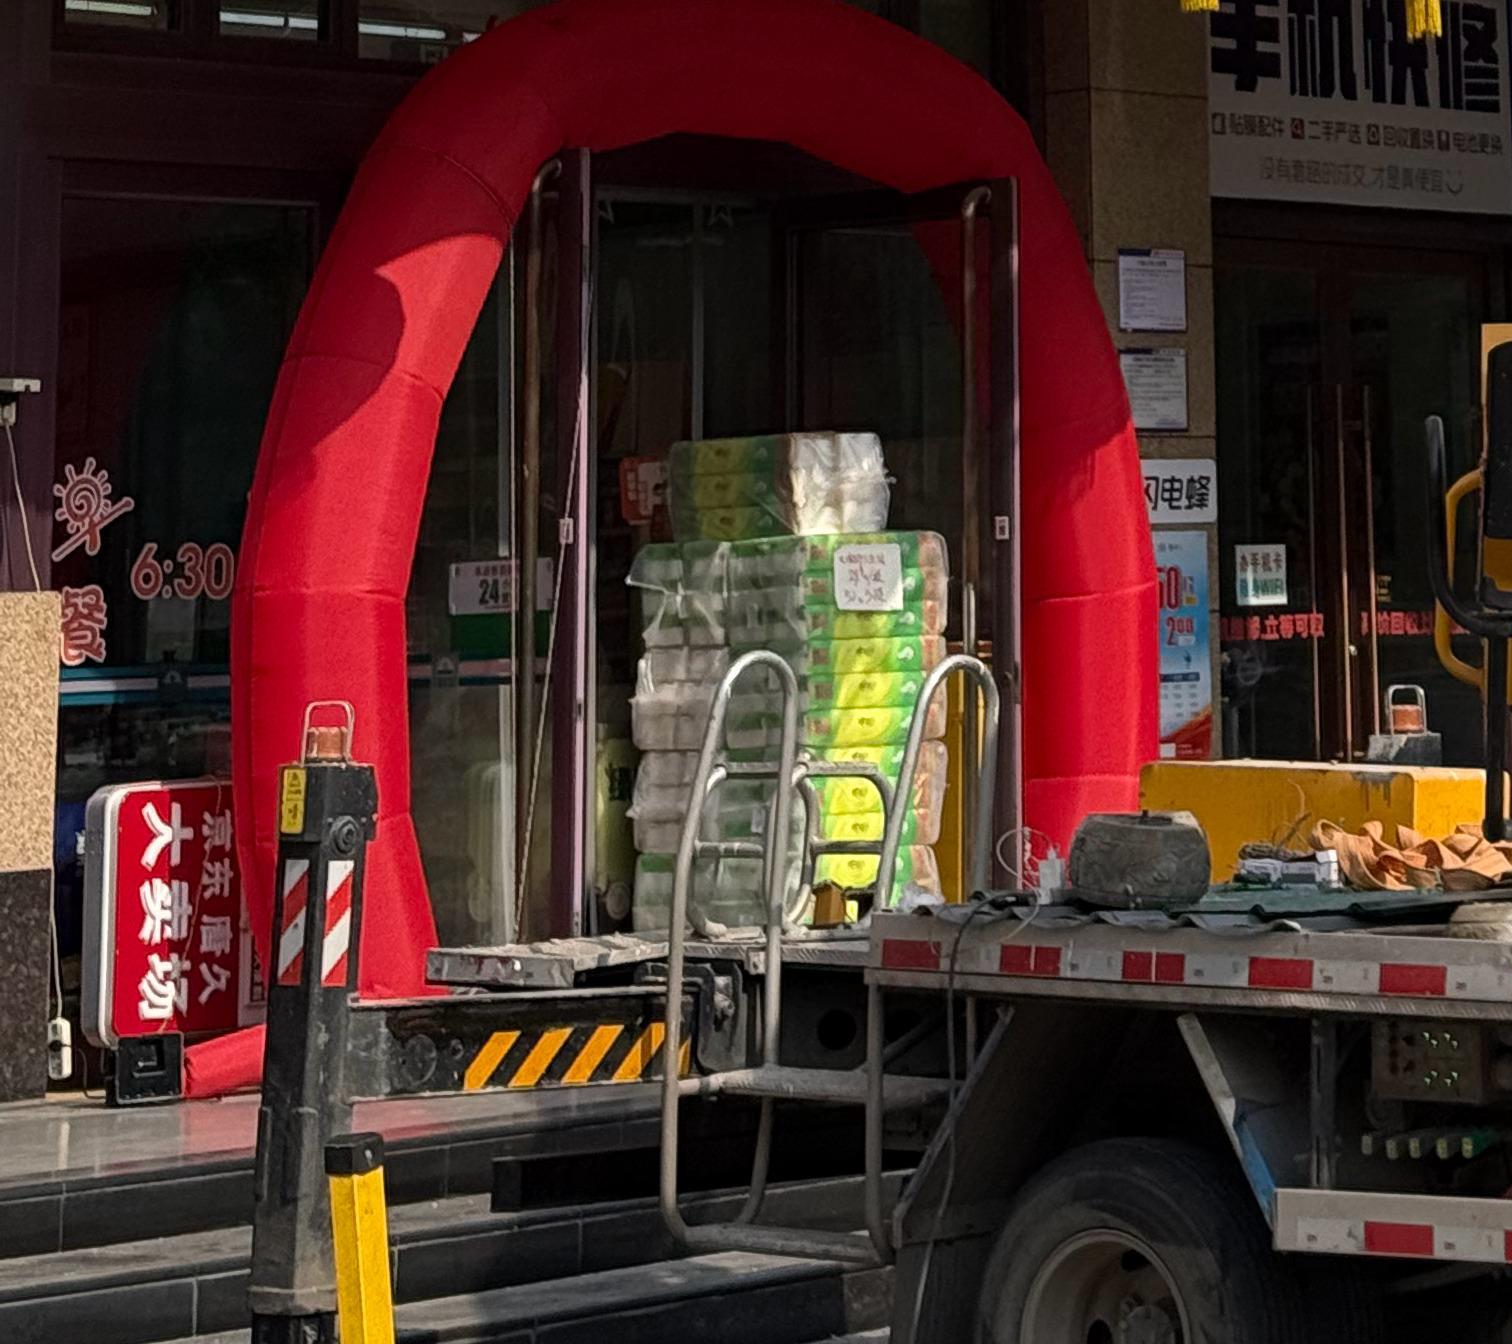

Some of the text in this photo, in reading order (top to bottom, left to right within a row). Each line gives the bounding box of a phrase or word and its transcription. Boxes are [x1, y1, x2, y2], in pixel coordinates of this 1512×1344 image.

[130, 542, 235, 600] 6:30
[138, 801, 195, 1021] 大卖场
